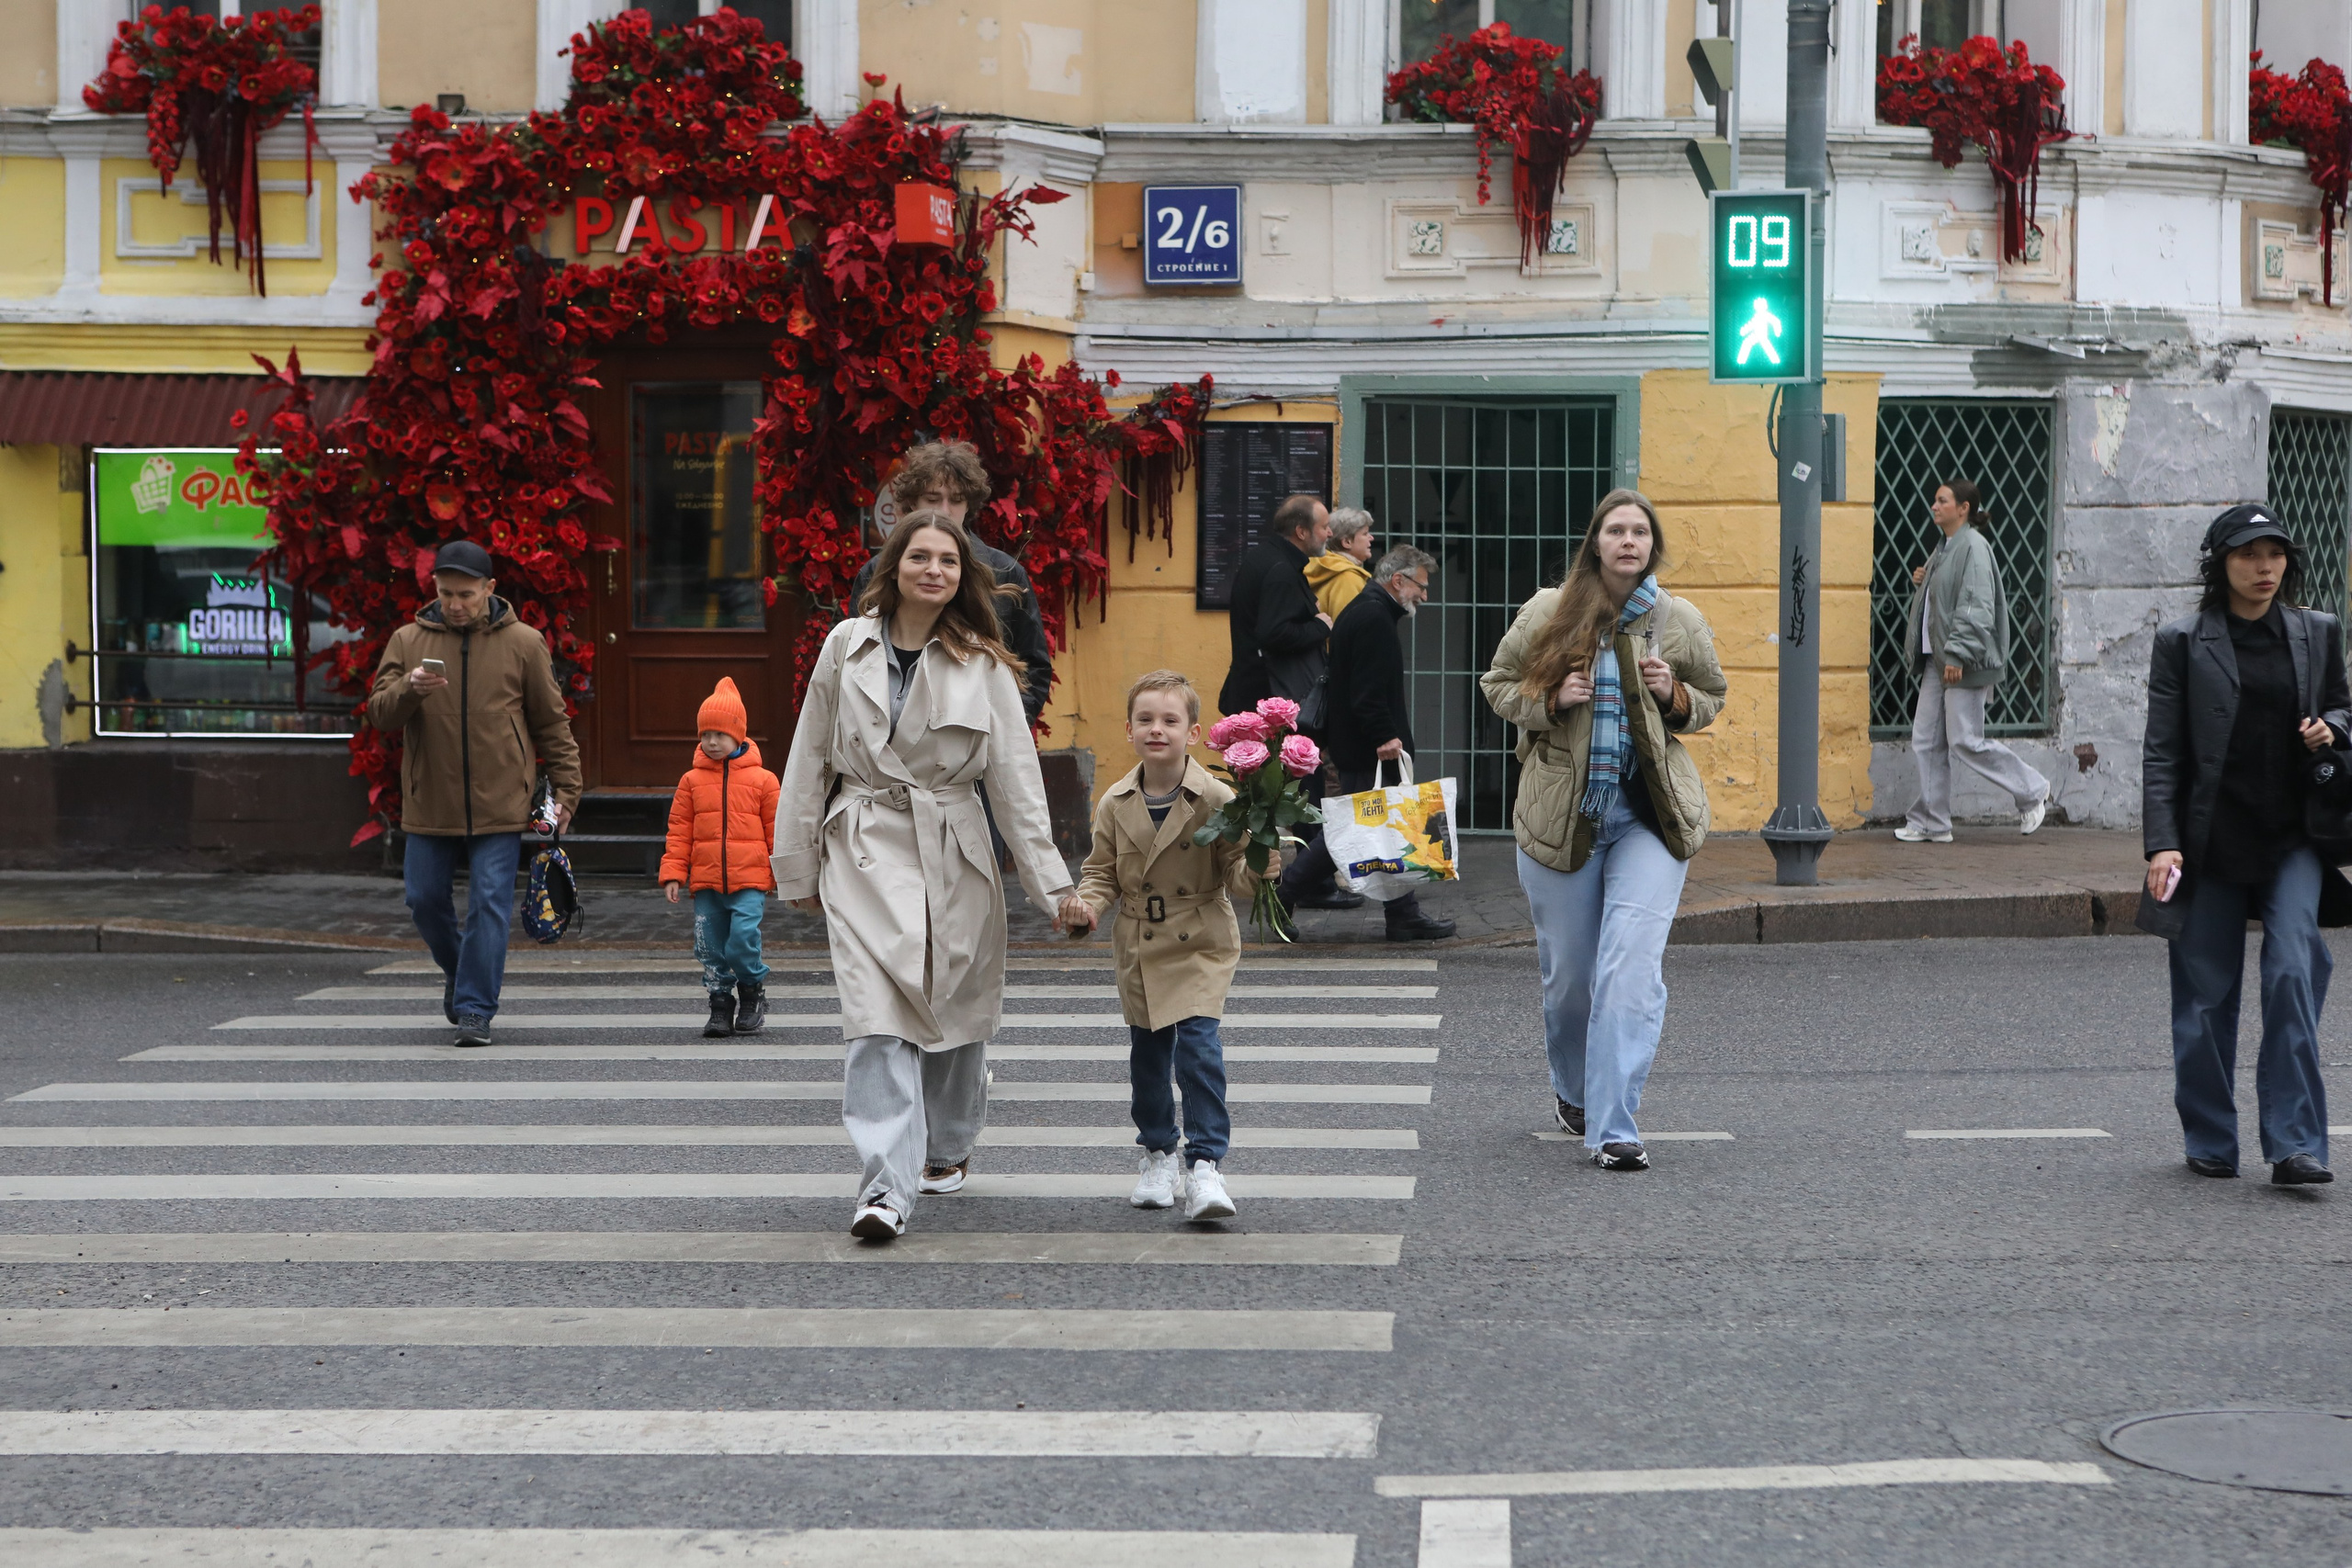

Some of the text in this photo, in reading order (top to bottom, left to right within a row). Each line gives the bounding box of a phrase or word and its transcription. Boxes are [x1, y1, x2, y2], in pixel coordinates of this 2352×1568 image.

[575, 194, 796, 254] PASTA
[930, 195, 953, 229] PASTA
[1157, 205, 1229, 254] 2/6
[1728, 215, 1791, 267] 09
[1157, 263, 1228, 273] СТРОЕНИЕ 1
[664, 431, 733, 455] PASTA
[180, 465, 271, 512] ФАС
[189, 608, 285, 641] GORILLA
[202, 643, 268, 655] ENERGY DRIN
[1362, 805, 1384, 817] ЛЕНТА
[1365, 862, 1398, 873] ЛЕНТА
